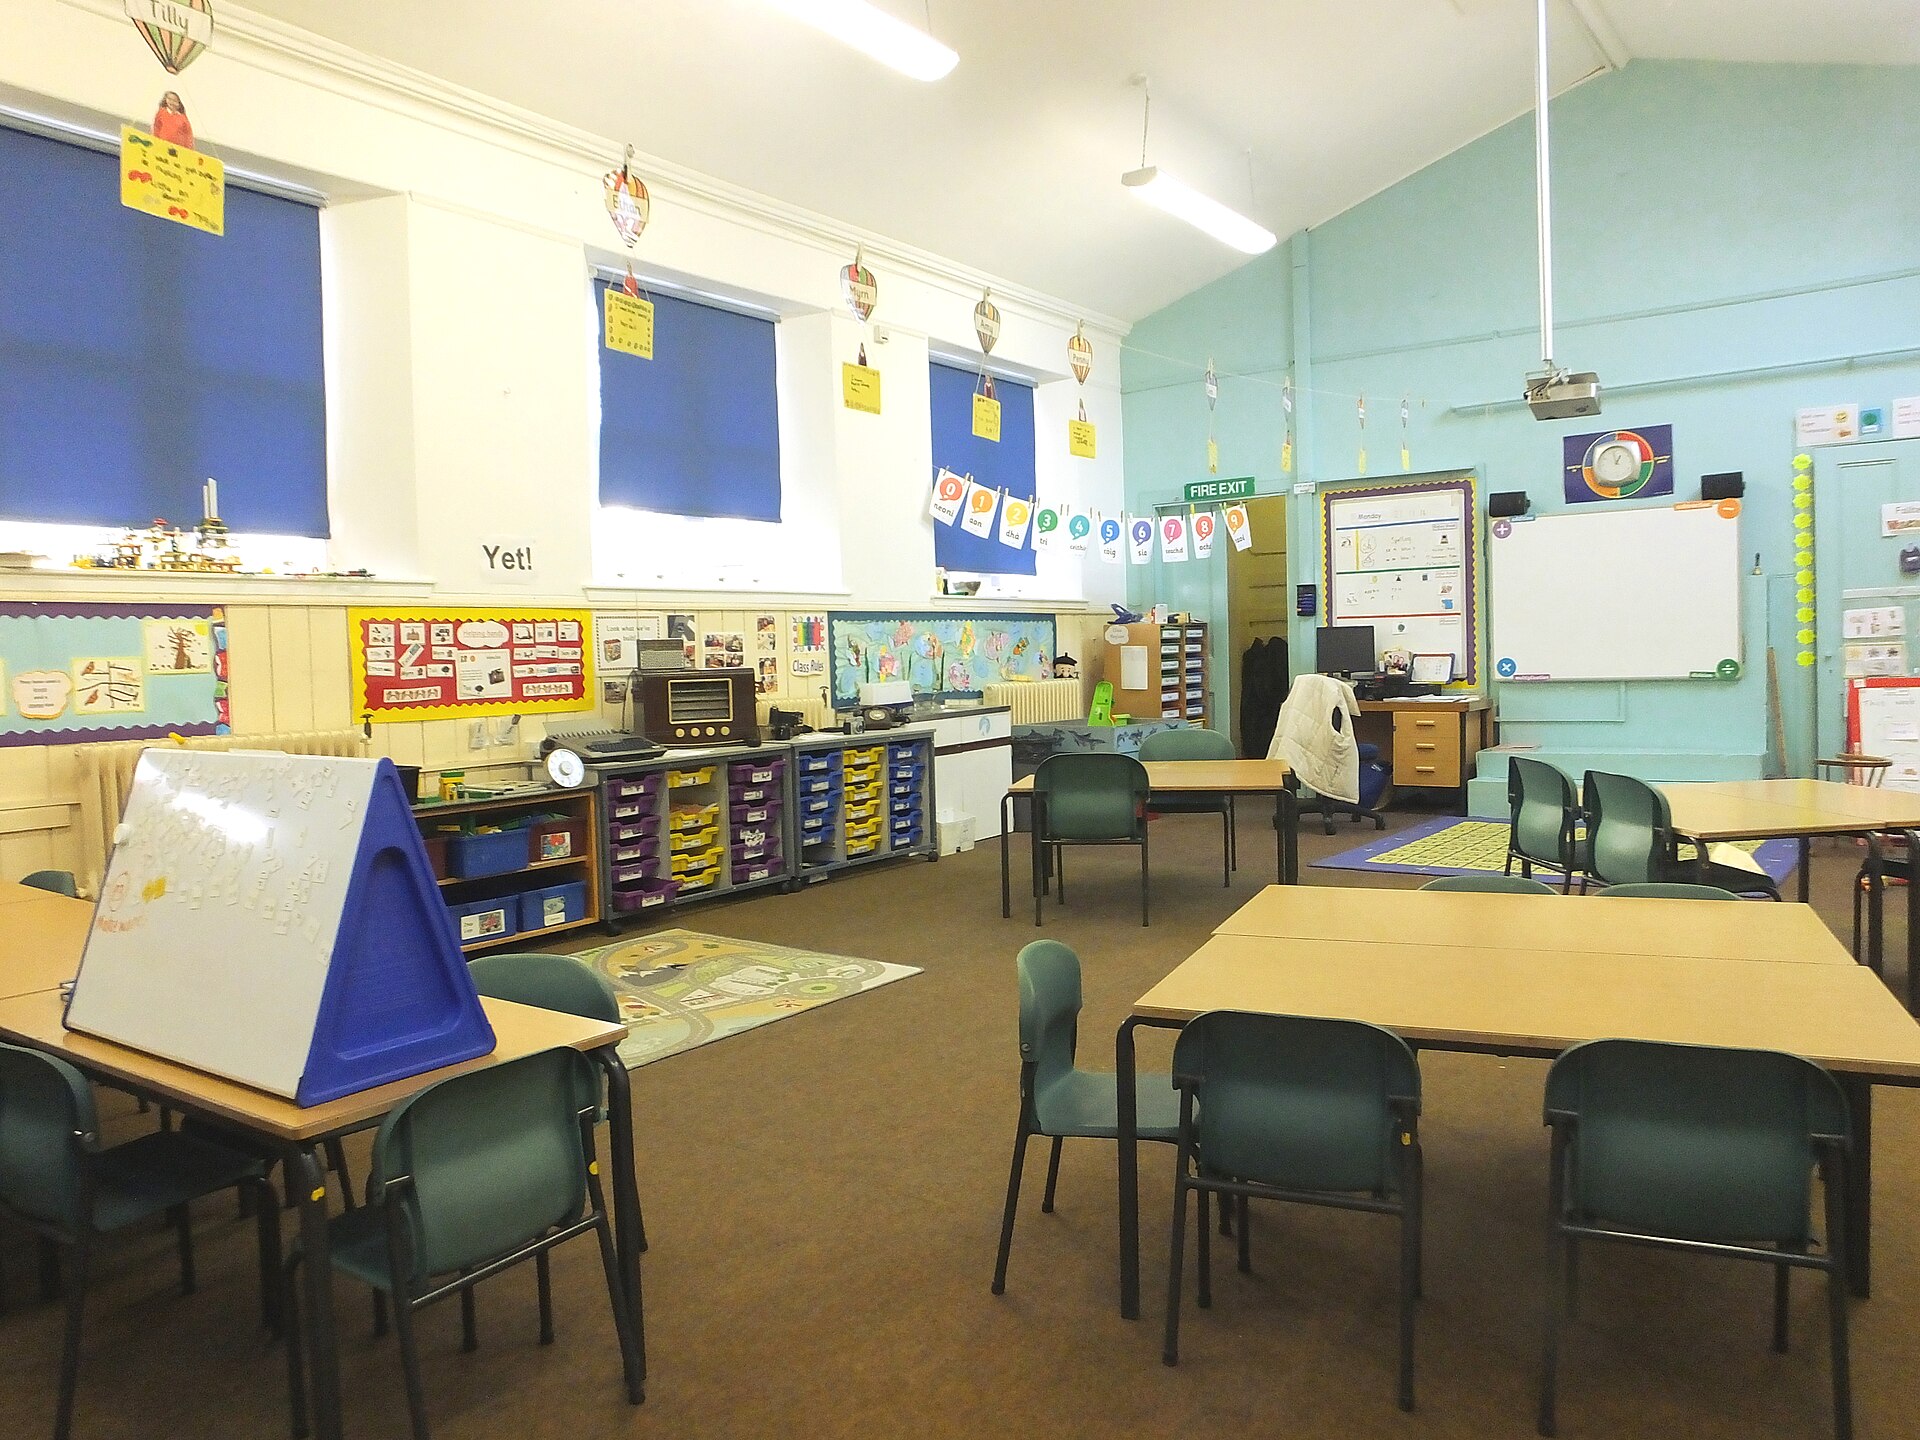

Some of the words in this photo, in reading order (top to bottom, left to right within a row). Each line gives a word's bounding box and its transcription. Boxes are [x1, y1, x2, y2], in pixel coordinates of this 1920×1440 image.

[151, 0, 189, 37] Tilly
[612, 199, 642, 217] Ethan
[979, 318, 994, 332] Amy
[945, 481, 957, 496] 0
[1190, 483, 1217, 498] FIRE
[1218, 480, 1247, 495] EXIT
[979, 495, 985, 507] 1
[933, 502, 954, 518] neoni
[1013, 508, 1022, 520] 2
[1358, 512, 1382, 521] Monday
[968, 516, 983, 528] aon
[1043, 514, 1051, 527] 3
[1075, 520, 1083, 532] 4
[1201, 520, 1210, 533] 8
[1231, 515, 1238, 526] 9
[1105, 524, 1114, 537] 5
[1138, 525, 1146, 538] 6
[1168, 524, 1176, 537] 7
[481, 544, 533, 571] Yet!
[1137, 549, 1148, 557] sia
[793, 659, 810, 674] Class
[811, 659, 825, 673] Rules
